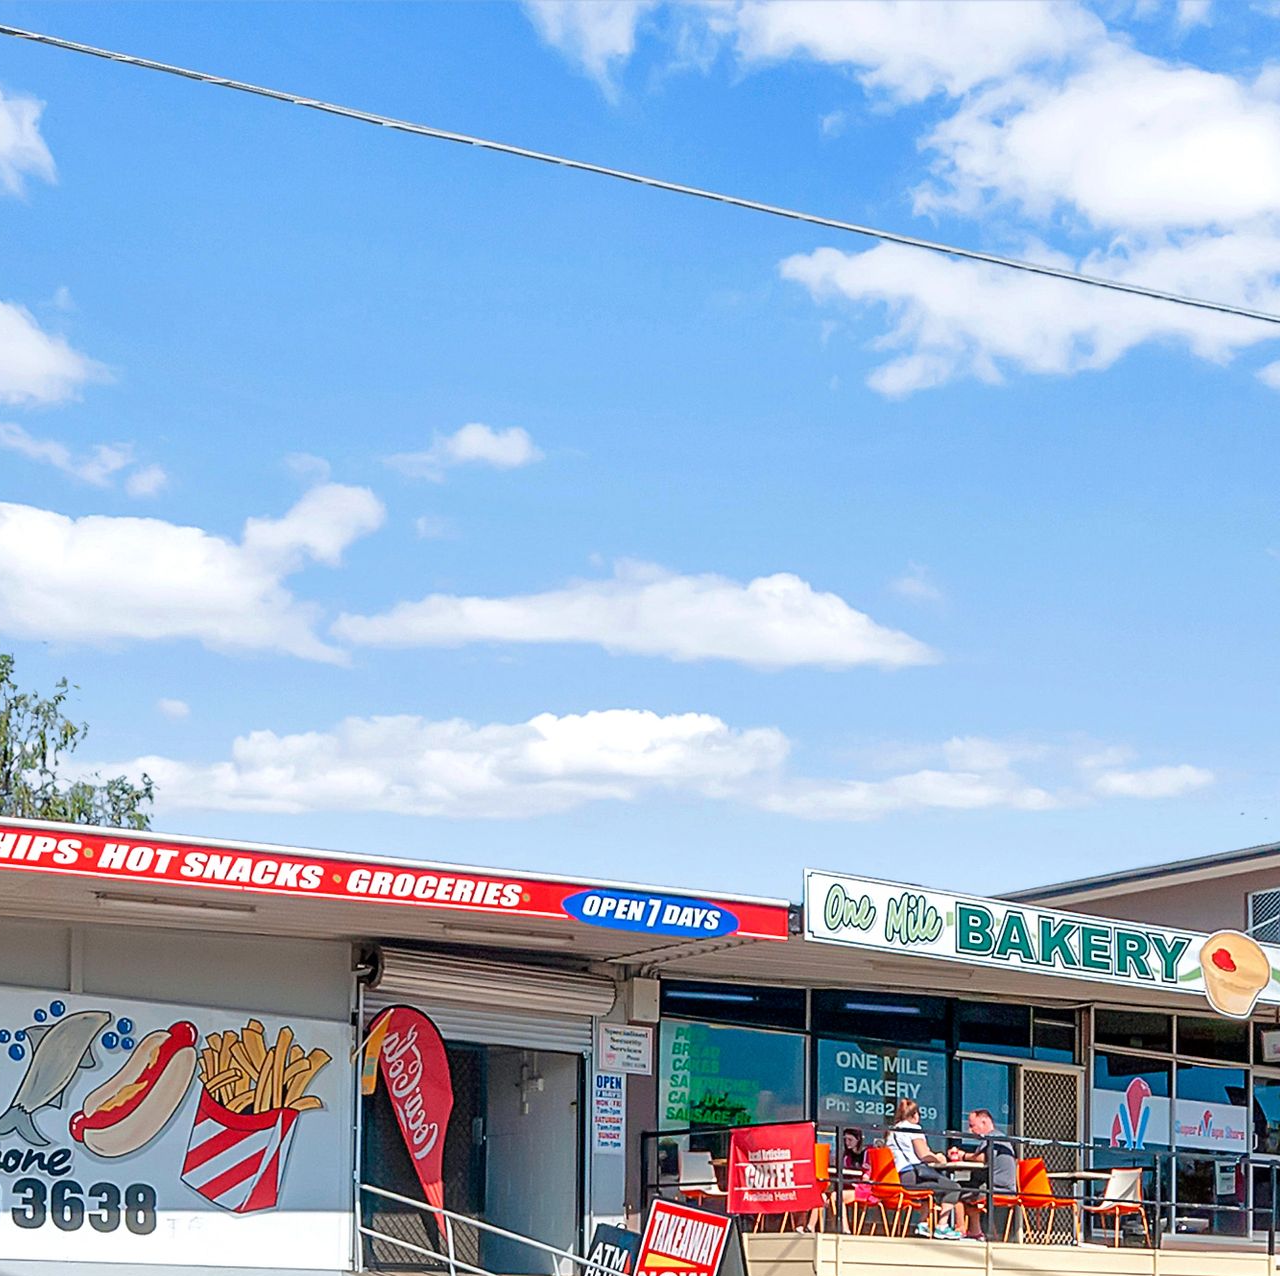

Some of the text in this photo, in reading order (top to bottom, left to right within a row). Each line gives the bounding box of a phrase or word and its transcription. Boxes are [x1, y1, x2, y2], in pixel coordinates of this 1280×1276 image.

[97, 843, 179, 874] HOT
[180, 851, 325, 889] SNACKS
[346, 869, 522, 908] GROCERIES
[581, 895, 722, 930] OPEN 7 DAYS
[824, 883, 1193, 984] One Mile BAKERY
[836, 1051, 929, 1076] ONE MILE
[596, 1074, 622, 1090] OPEN
[843, 1076, 922, 1099] BAKERY
[825, 1098, 850, 1112] Ph:
[854, 1100, 895, 1117] 3282
[744, 1163, 796, 1189] COFFEE
[11, 1177, 157, 1235] 3638
[648, 1210, 724, 1267] TAKEAWAY
[588, 1241, 629, 1272] ATM
